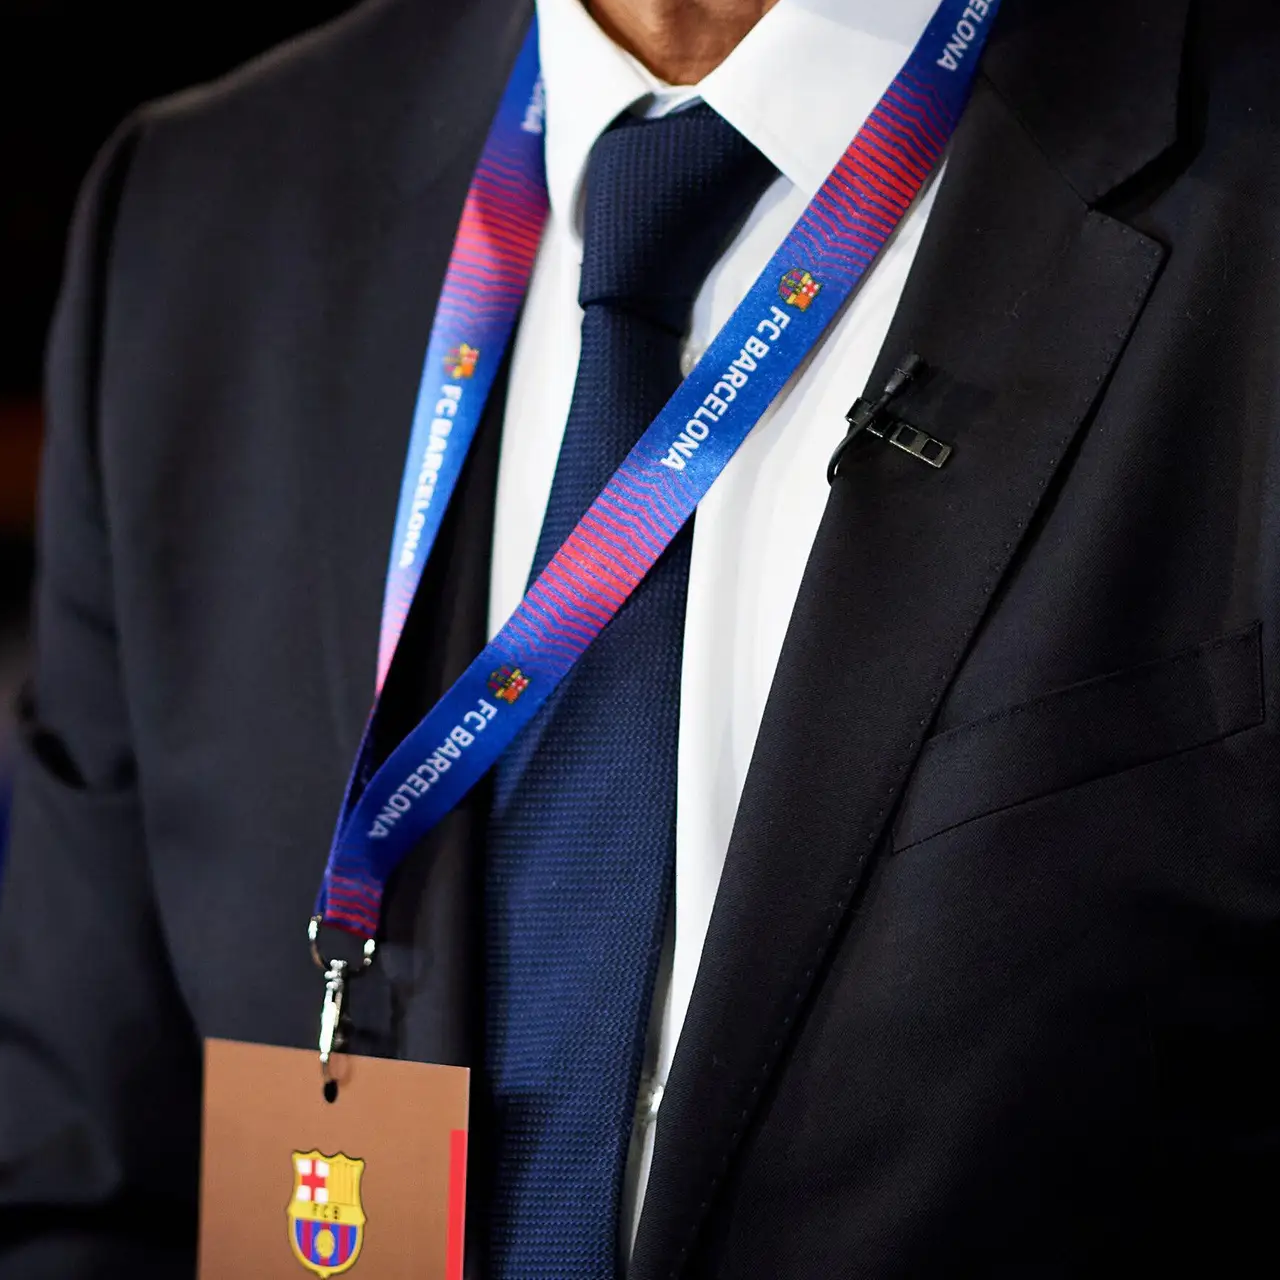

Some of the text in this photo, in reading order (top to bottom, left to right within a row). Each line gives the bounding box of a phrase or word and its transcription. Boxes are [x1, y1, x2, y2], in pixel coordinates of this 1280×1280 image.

[660, 305, 791, 471] FC BARCELONA
[398, 384, 463, 568] FC BARCELONA
[368, 698, 498, 838] FC BARCELONA
